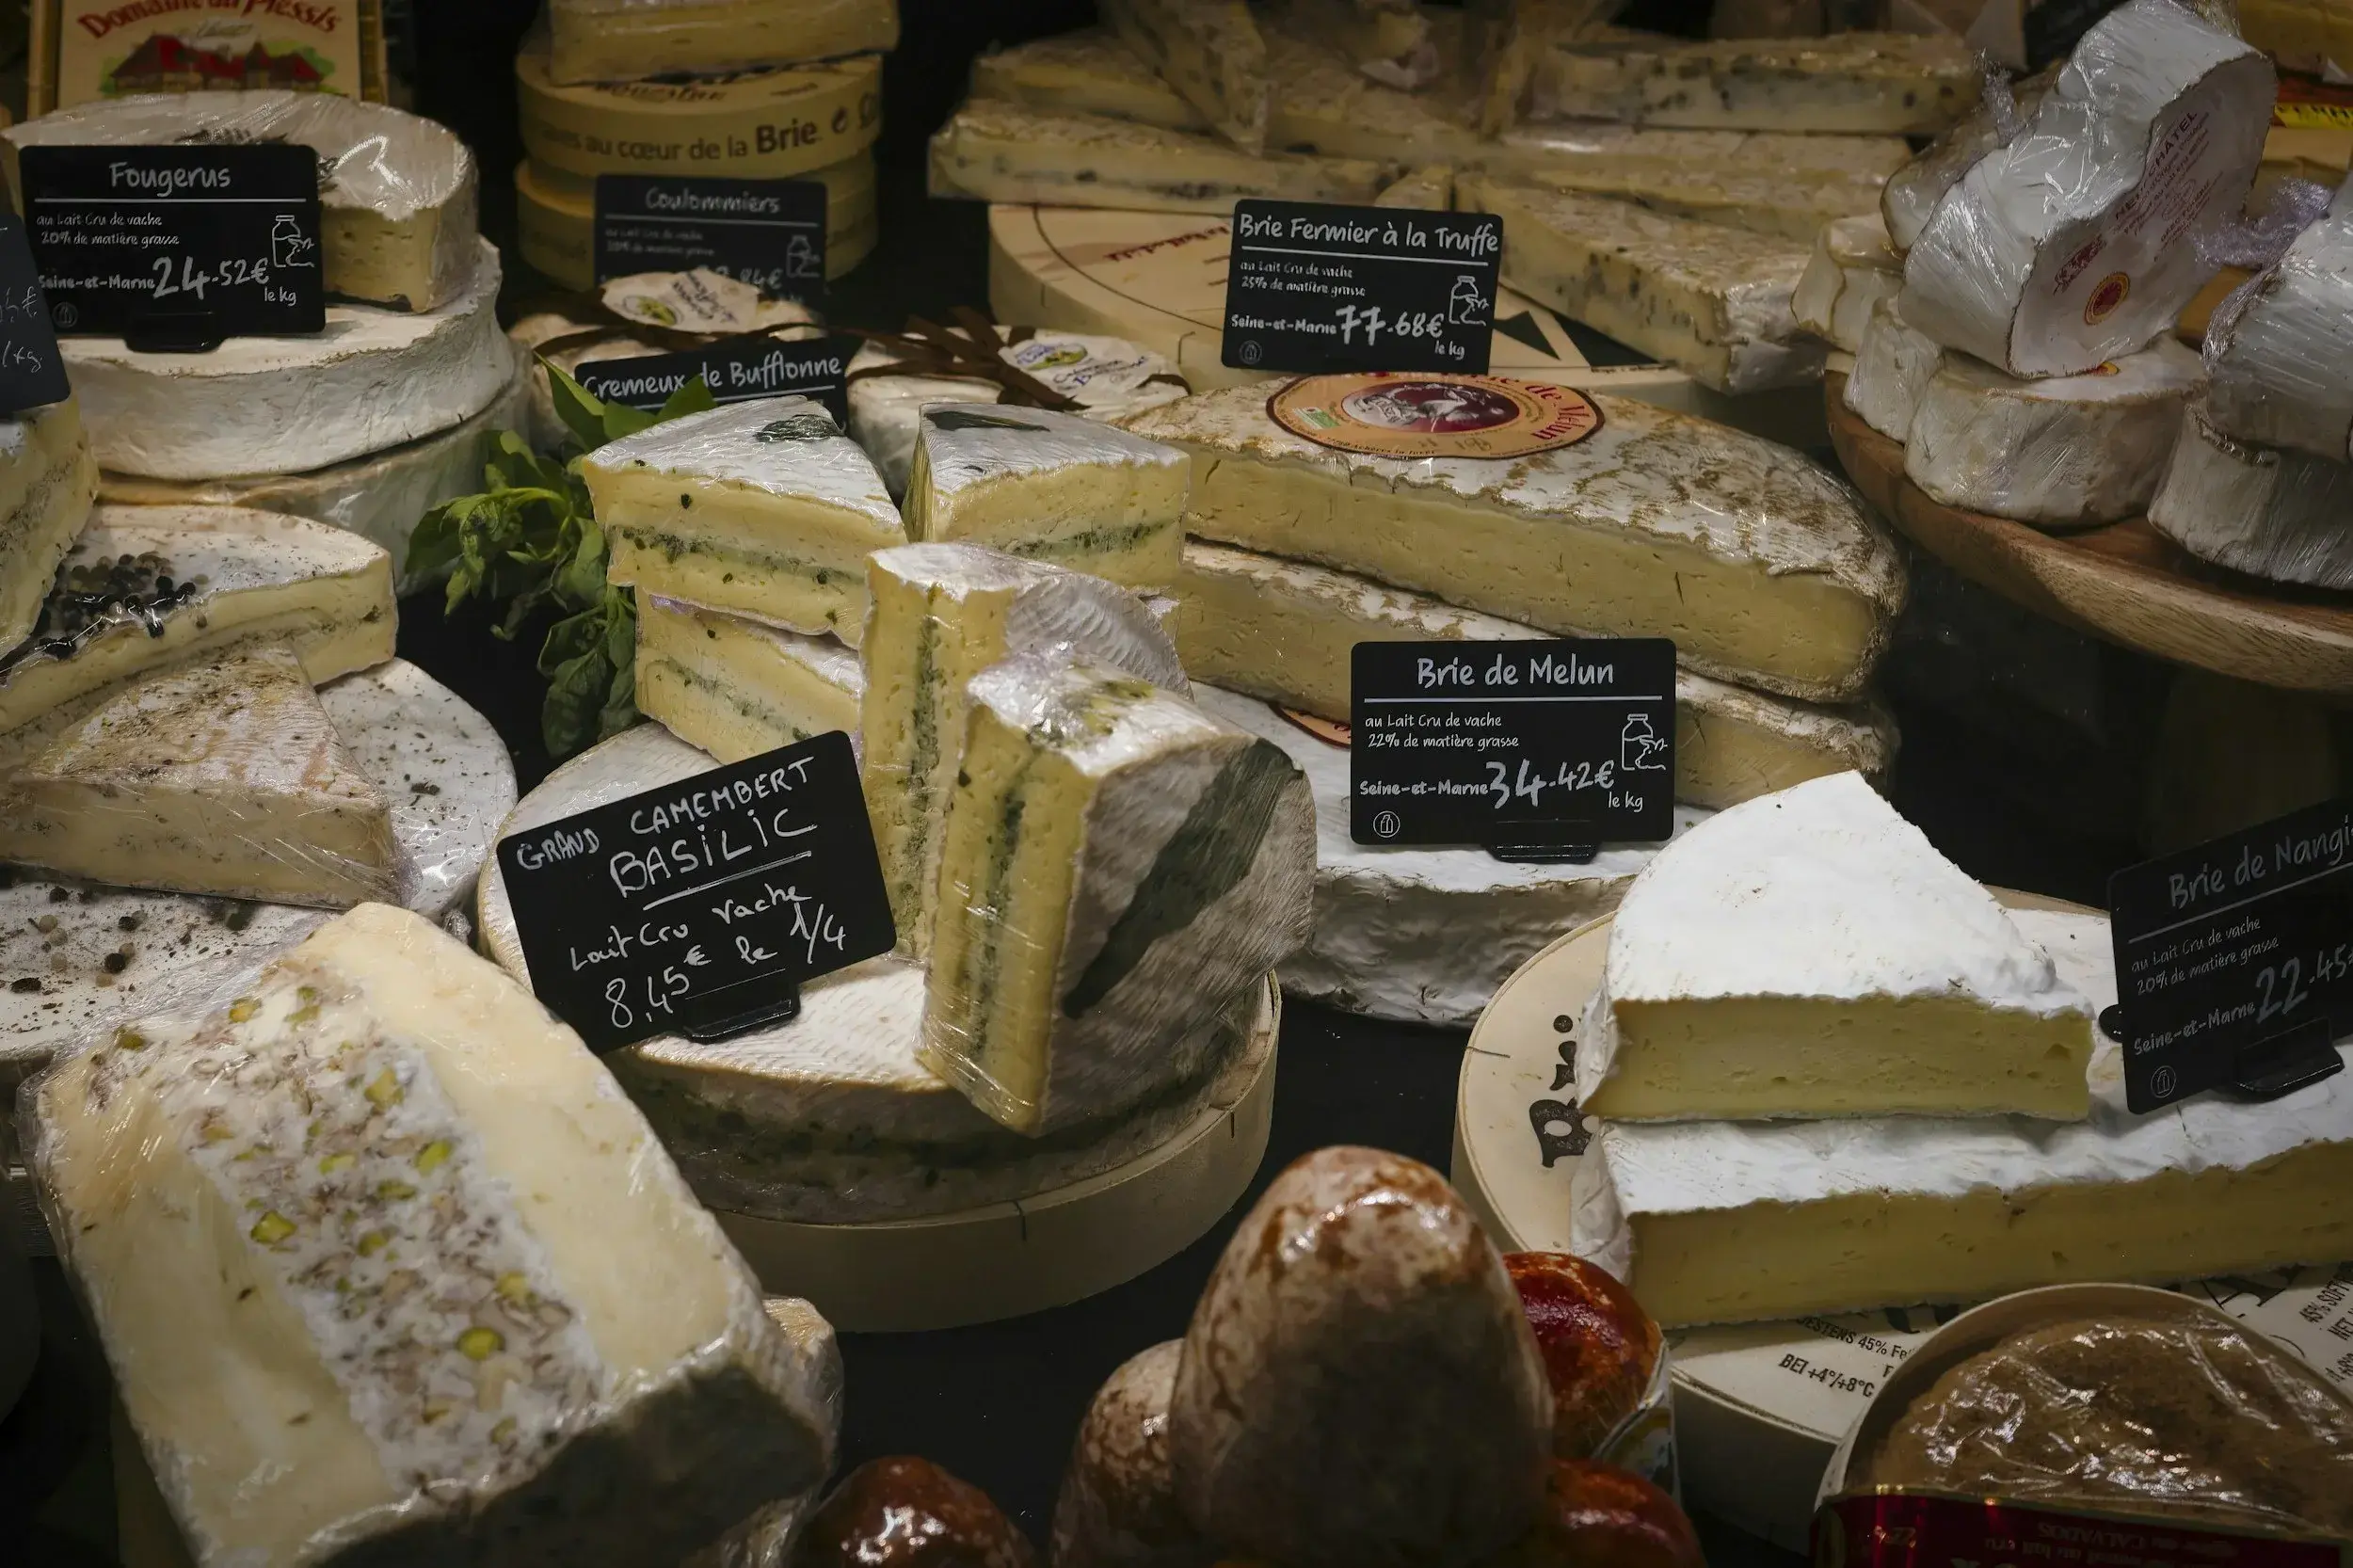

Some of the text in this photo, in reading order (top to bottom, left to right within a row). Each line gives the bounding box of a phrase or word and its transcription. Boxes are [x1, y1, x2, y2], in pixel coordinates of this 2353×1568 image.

[586, 136, 612, 156] au
[689, 136, 721, 161] de
[728, 134, 748, 158] la
[756, 121, 819, 154] Brie
[108, 161, 232, 198] Fougerus
[645, 186, 781, 215] Coulommiers
[37, 216, 53, 226] au
[109, 213, 125, 226] de
[127, 214, 163, 226] vache
[1239, 213, 1499, 257] Brie Fermier à la Truffe
[40, 231, 72, 246] 20%
[73, 232, 88, 246] de
[91, 232, 138, 246] matière
[38, 256, 269, 300] Seine-et-Marne 24.52€
[1271, 277, 1283, 291] de
[1305, 262, 1320, 276] de
[264, 287, 297, 306] le kg
[1230, 304, 1445, 345] Seine-et-Marne 77.68€
[1434, 341, 1465, 360] le kg
[584, 374, 685, 400] Cremeux
[730, 349, 843, 389] Bufflonne
[1417, 652, 1614, 689] Brie de Melun
[1365, 712, 1502, 728] au Lait Cru de vache
[1368, 731, 1519, 751] 22% de matière grasse
[1359, 759, 1614, 809] Seine-et-Marne 34.42€
[1608, 791, 1644, 813] le kg
[517, 756, 815, 871] GRAND CAMEMBERT
[2169, 813, 2353, 910] Brie de Nangi
[570, 926, 632, 971] Lait
[2131, 915, 2261, 973] au Lait Cru de vache
[2137, 936, 2280, 996] 20% de matière grasse
[2133, 942, 2353, 1056] Seine-et-Marne 22.45
[1858, 1336, 1887, 1355] 45%
[1891, 1344, 1915, 1361] Fe
